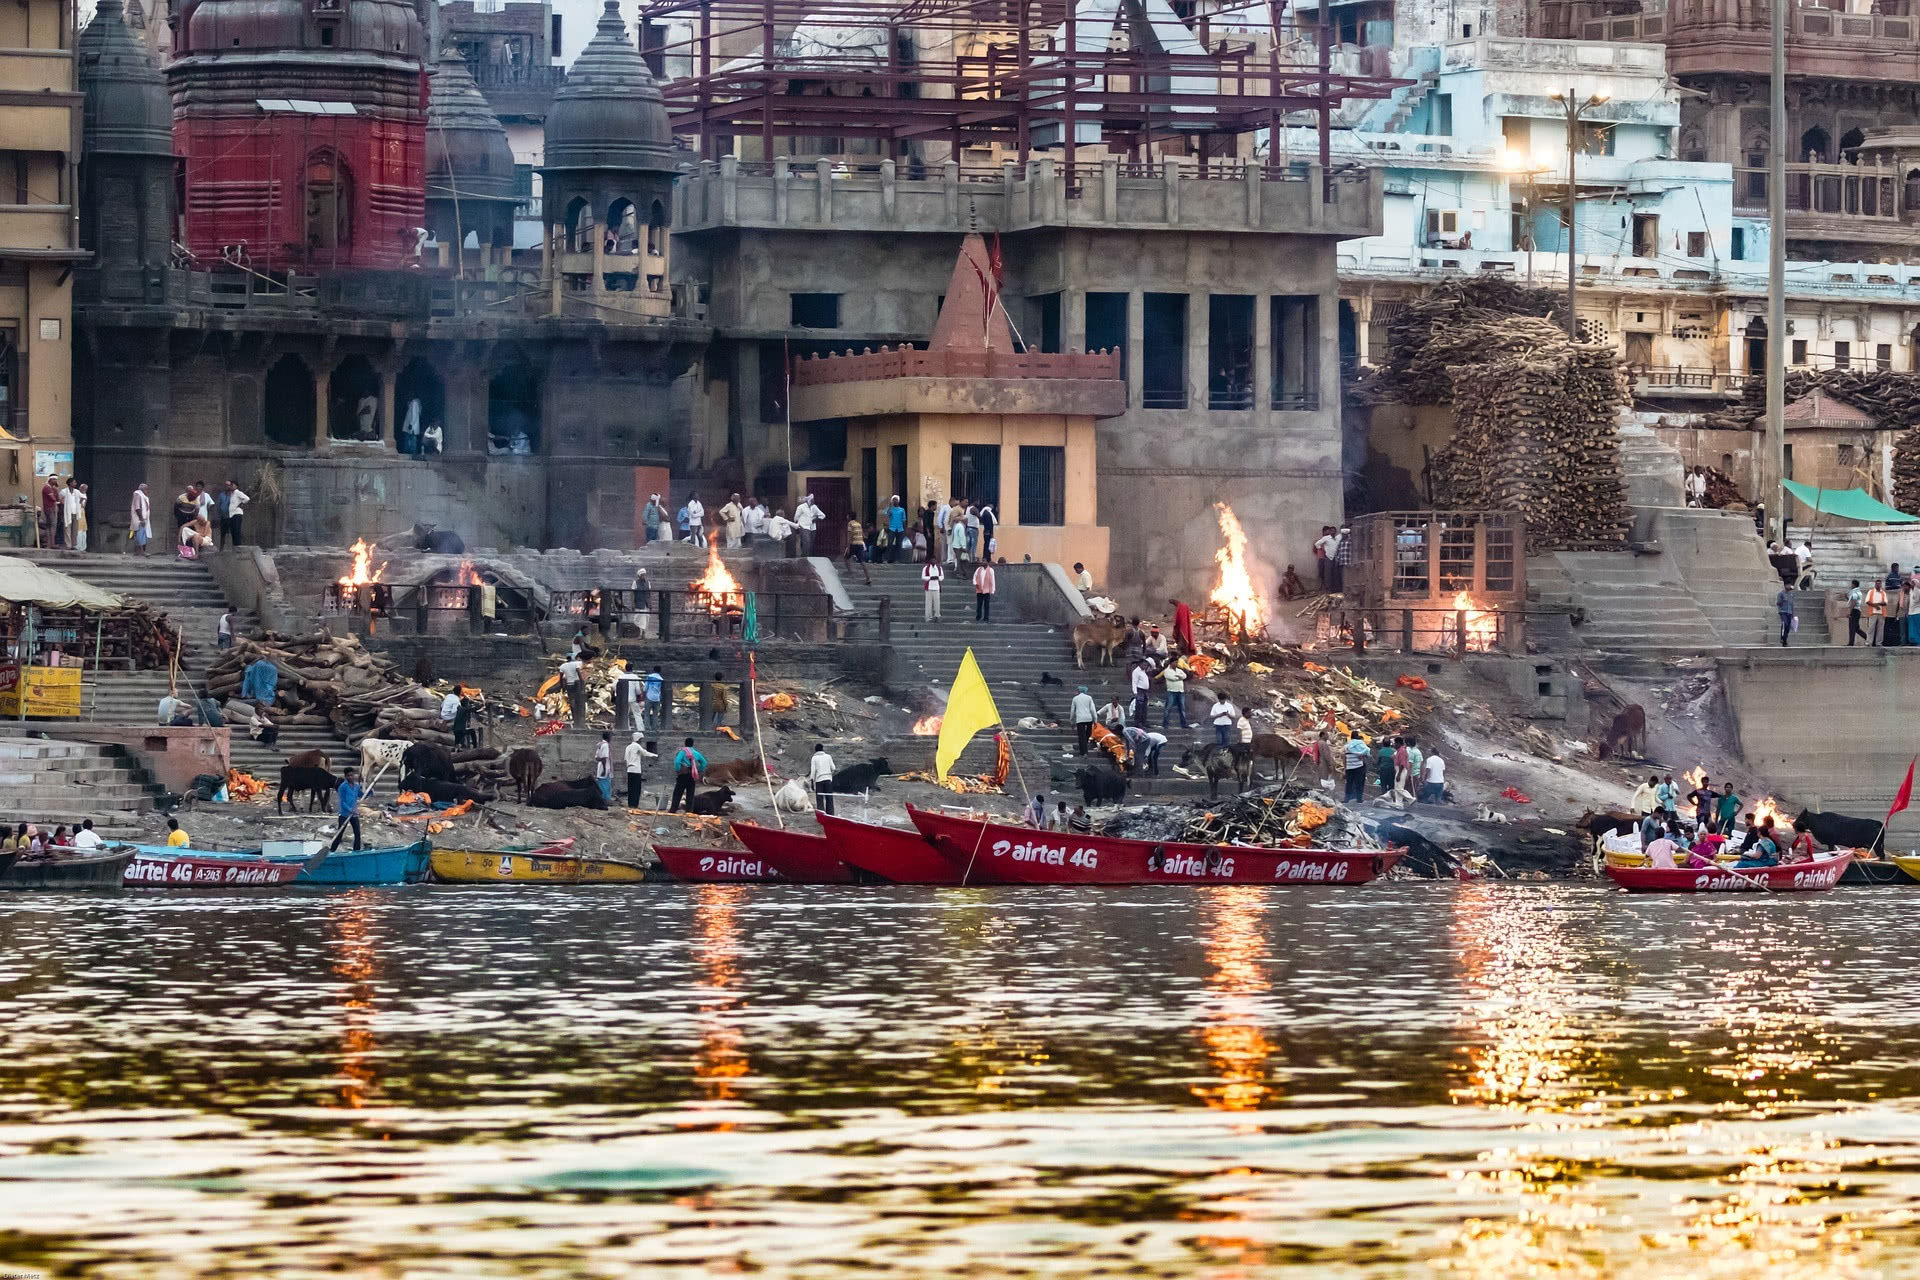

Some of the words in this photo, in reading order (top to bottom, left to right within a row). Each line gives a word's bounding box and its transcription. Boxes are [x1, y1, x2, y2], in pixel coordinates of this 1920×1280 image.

[1012, 841, 1066, 866] airtel
[1069, 847, 1098, 869] 4G
[1163, 853, 1208, 877] airtel
[124, 860, 168, 882] airtel
[171, 863, 193, 882] 4G
[236, 867, 267, 884] airtel
[717, 856, 763, 876] airtel
[1288, 860, 1326, 881] airtel
[1327, 861, 1349, 881] 4G
[1803, 869, 1828, 887] airtel
[1827, 866, 1837, 884] 4G
[1710, 874, 1748, 890] airtel
